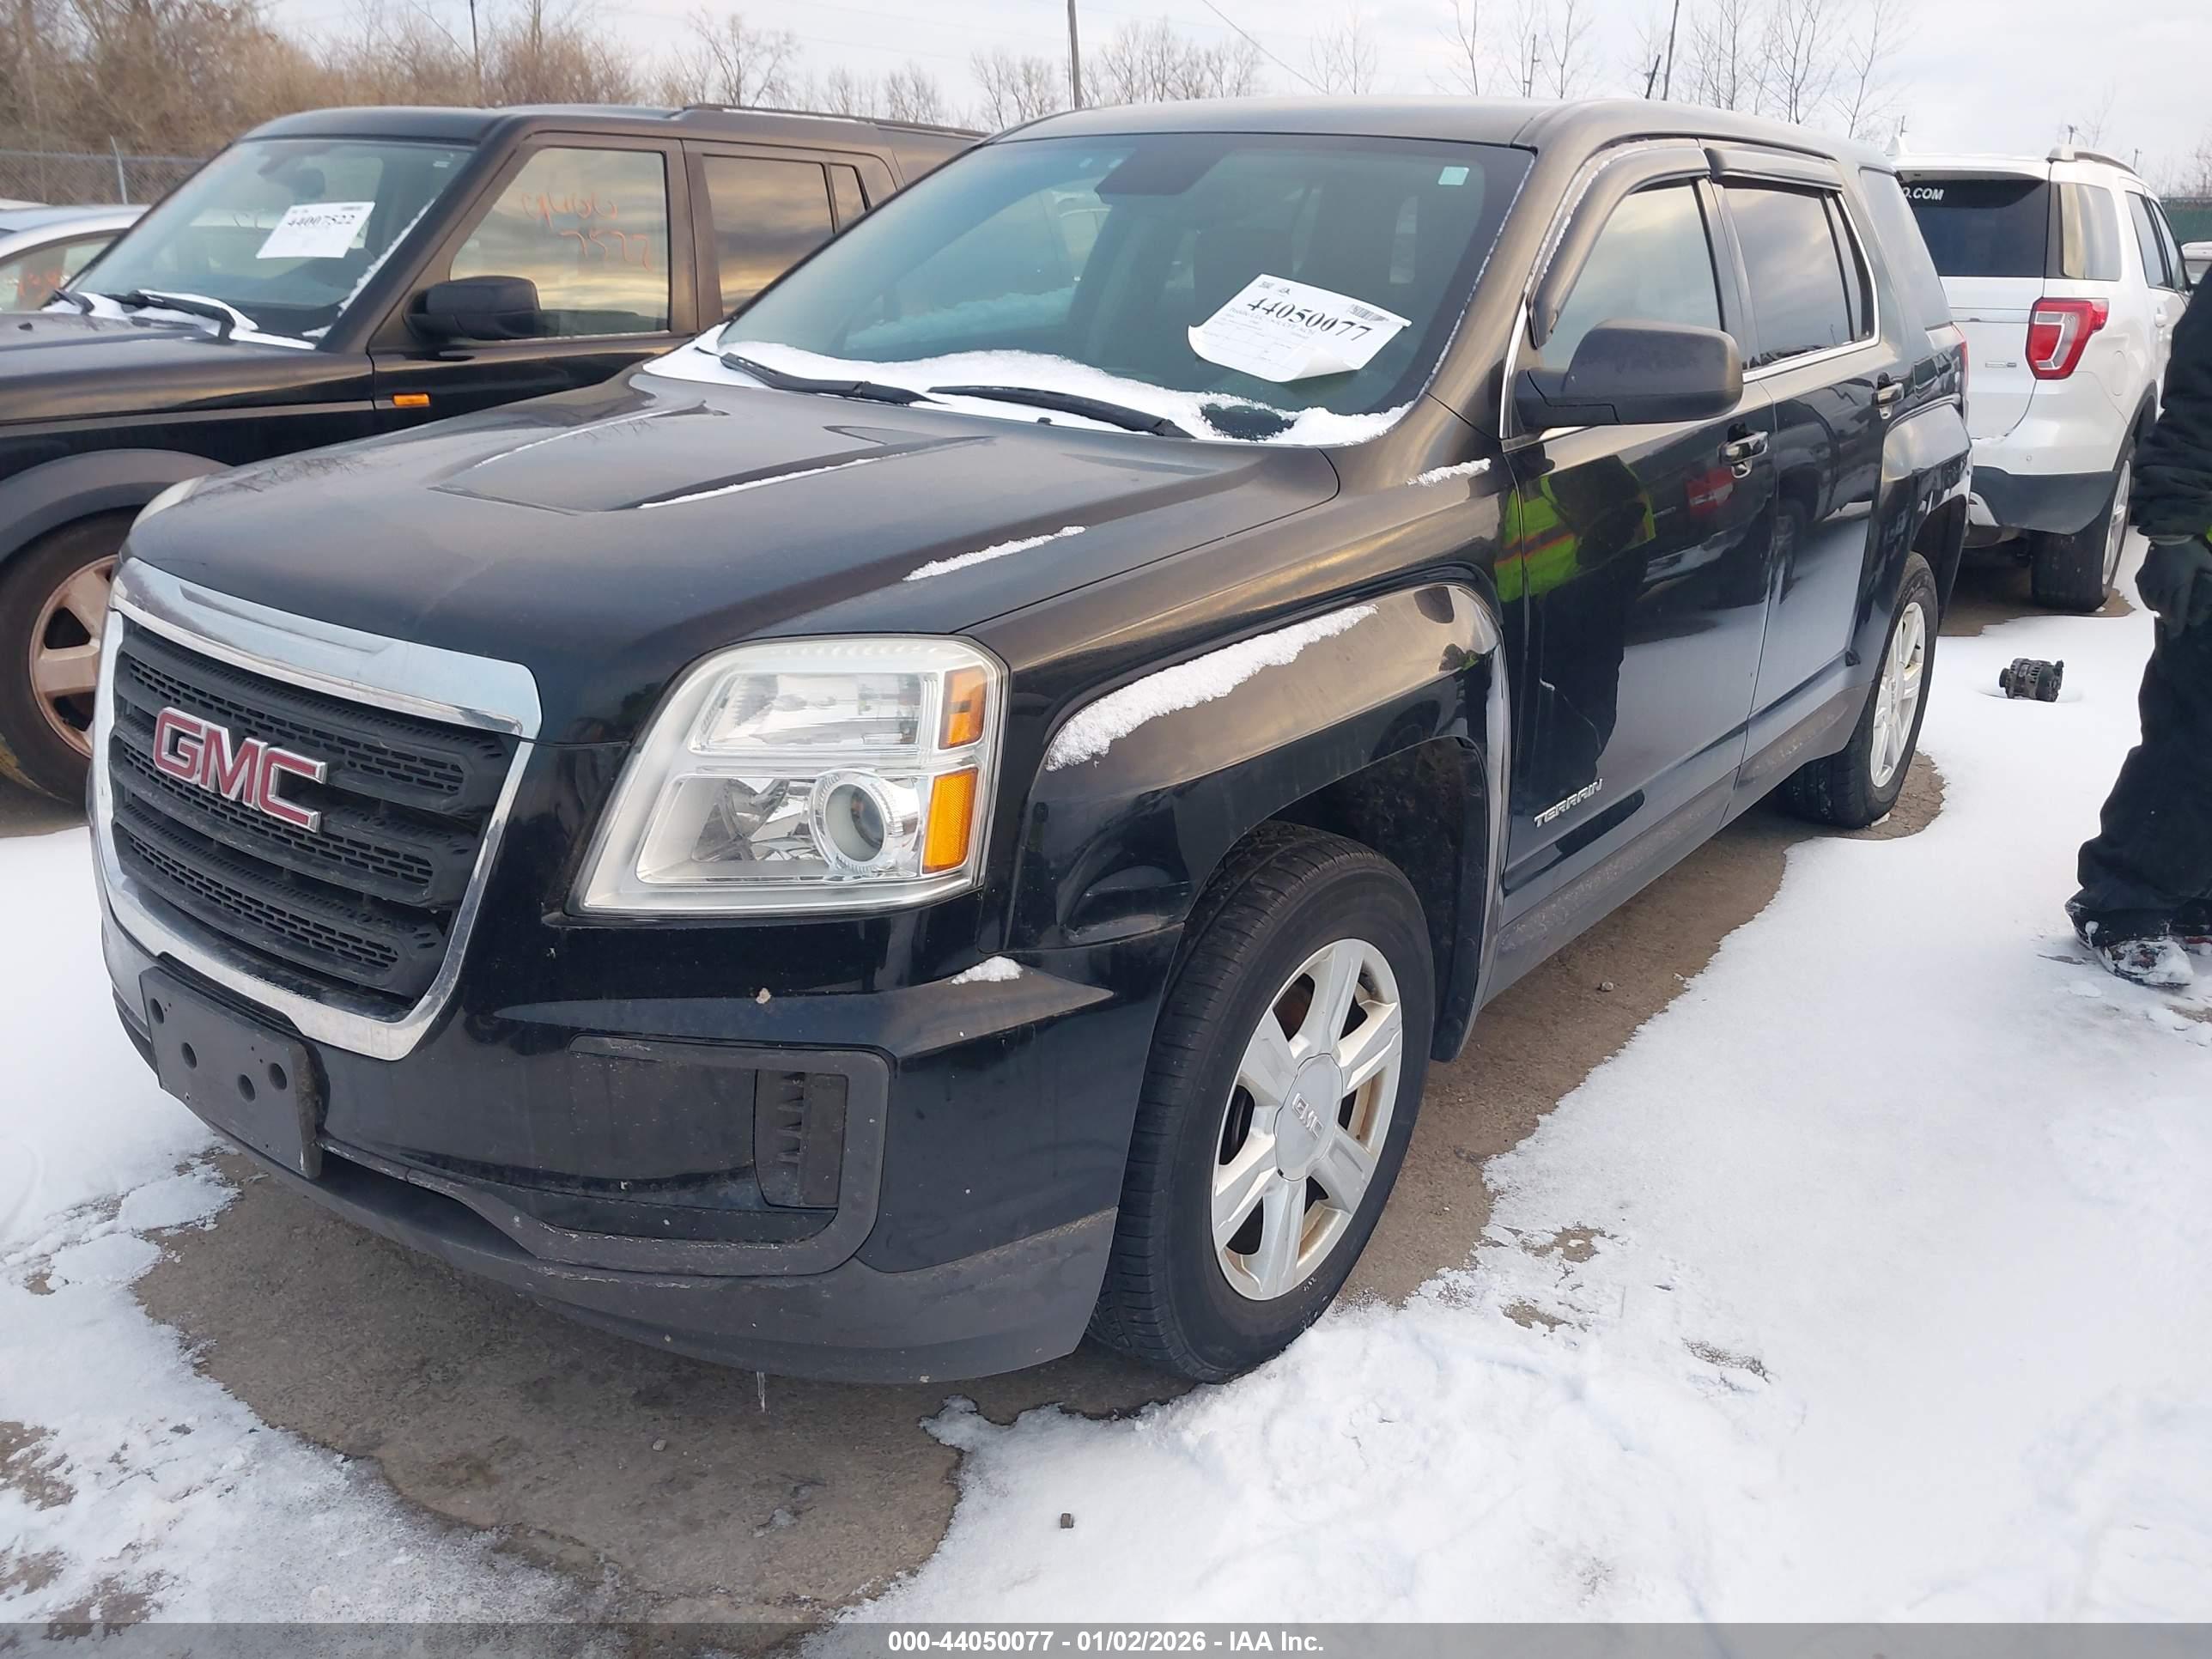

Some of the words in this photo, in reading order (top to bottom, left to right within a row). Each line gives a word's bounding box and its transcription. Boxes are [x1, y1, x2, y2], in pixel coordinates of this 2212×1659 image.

[1246, 297, 1373, 342] 44050077
[153, 706, 329, 834] GMC
[1533, 777, 1603, 829] TERRAIN
[1291, 1092, 1324, 1140] GMC
